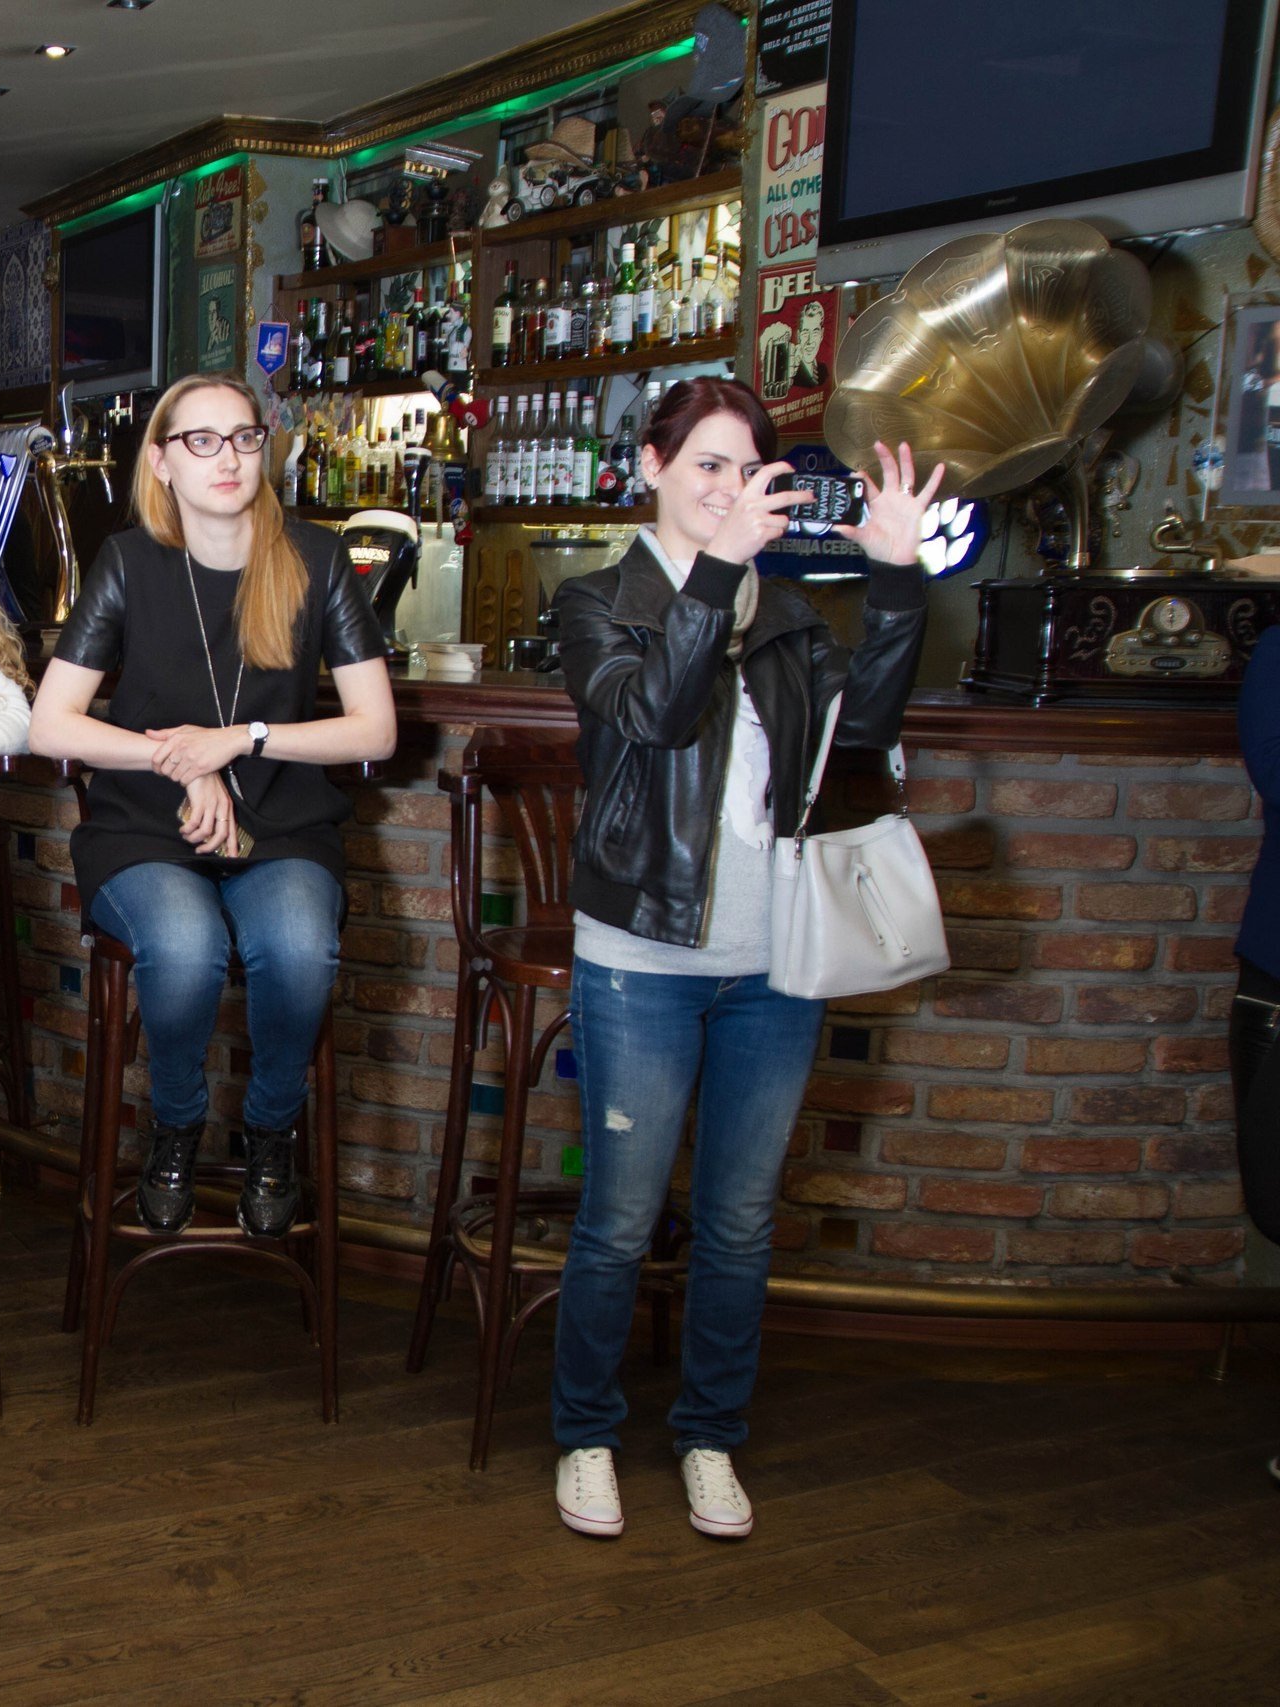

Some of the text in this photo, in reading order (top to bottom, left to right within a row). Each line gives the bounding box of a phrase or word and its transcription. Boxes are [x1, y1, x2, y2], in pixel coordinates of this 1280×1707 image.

[787, 12, 818, 29] ALWAYS
[767, 183, 789, 204] ALL
[832, 481, 848, 520] AVADA
[822, 539, 865, 556] СЕВЕ
